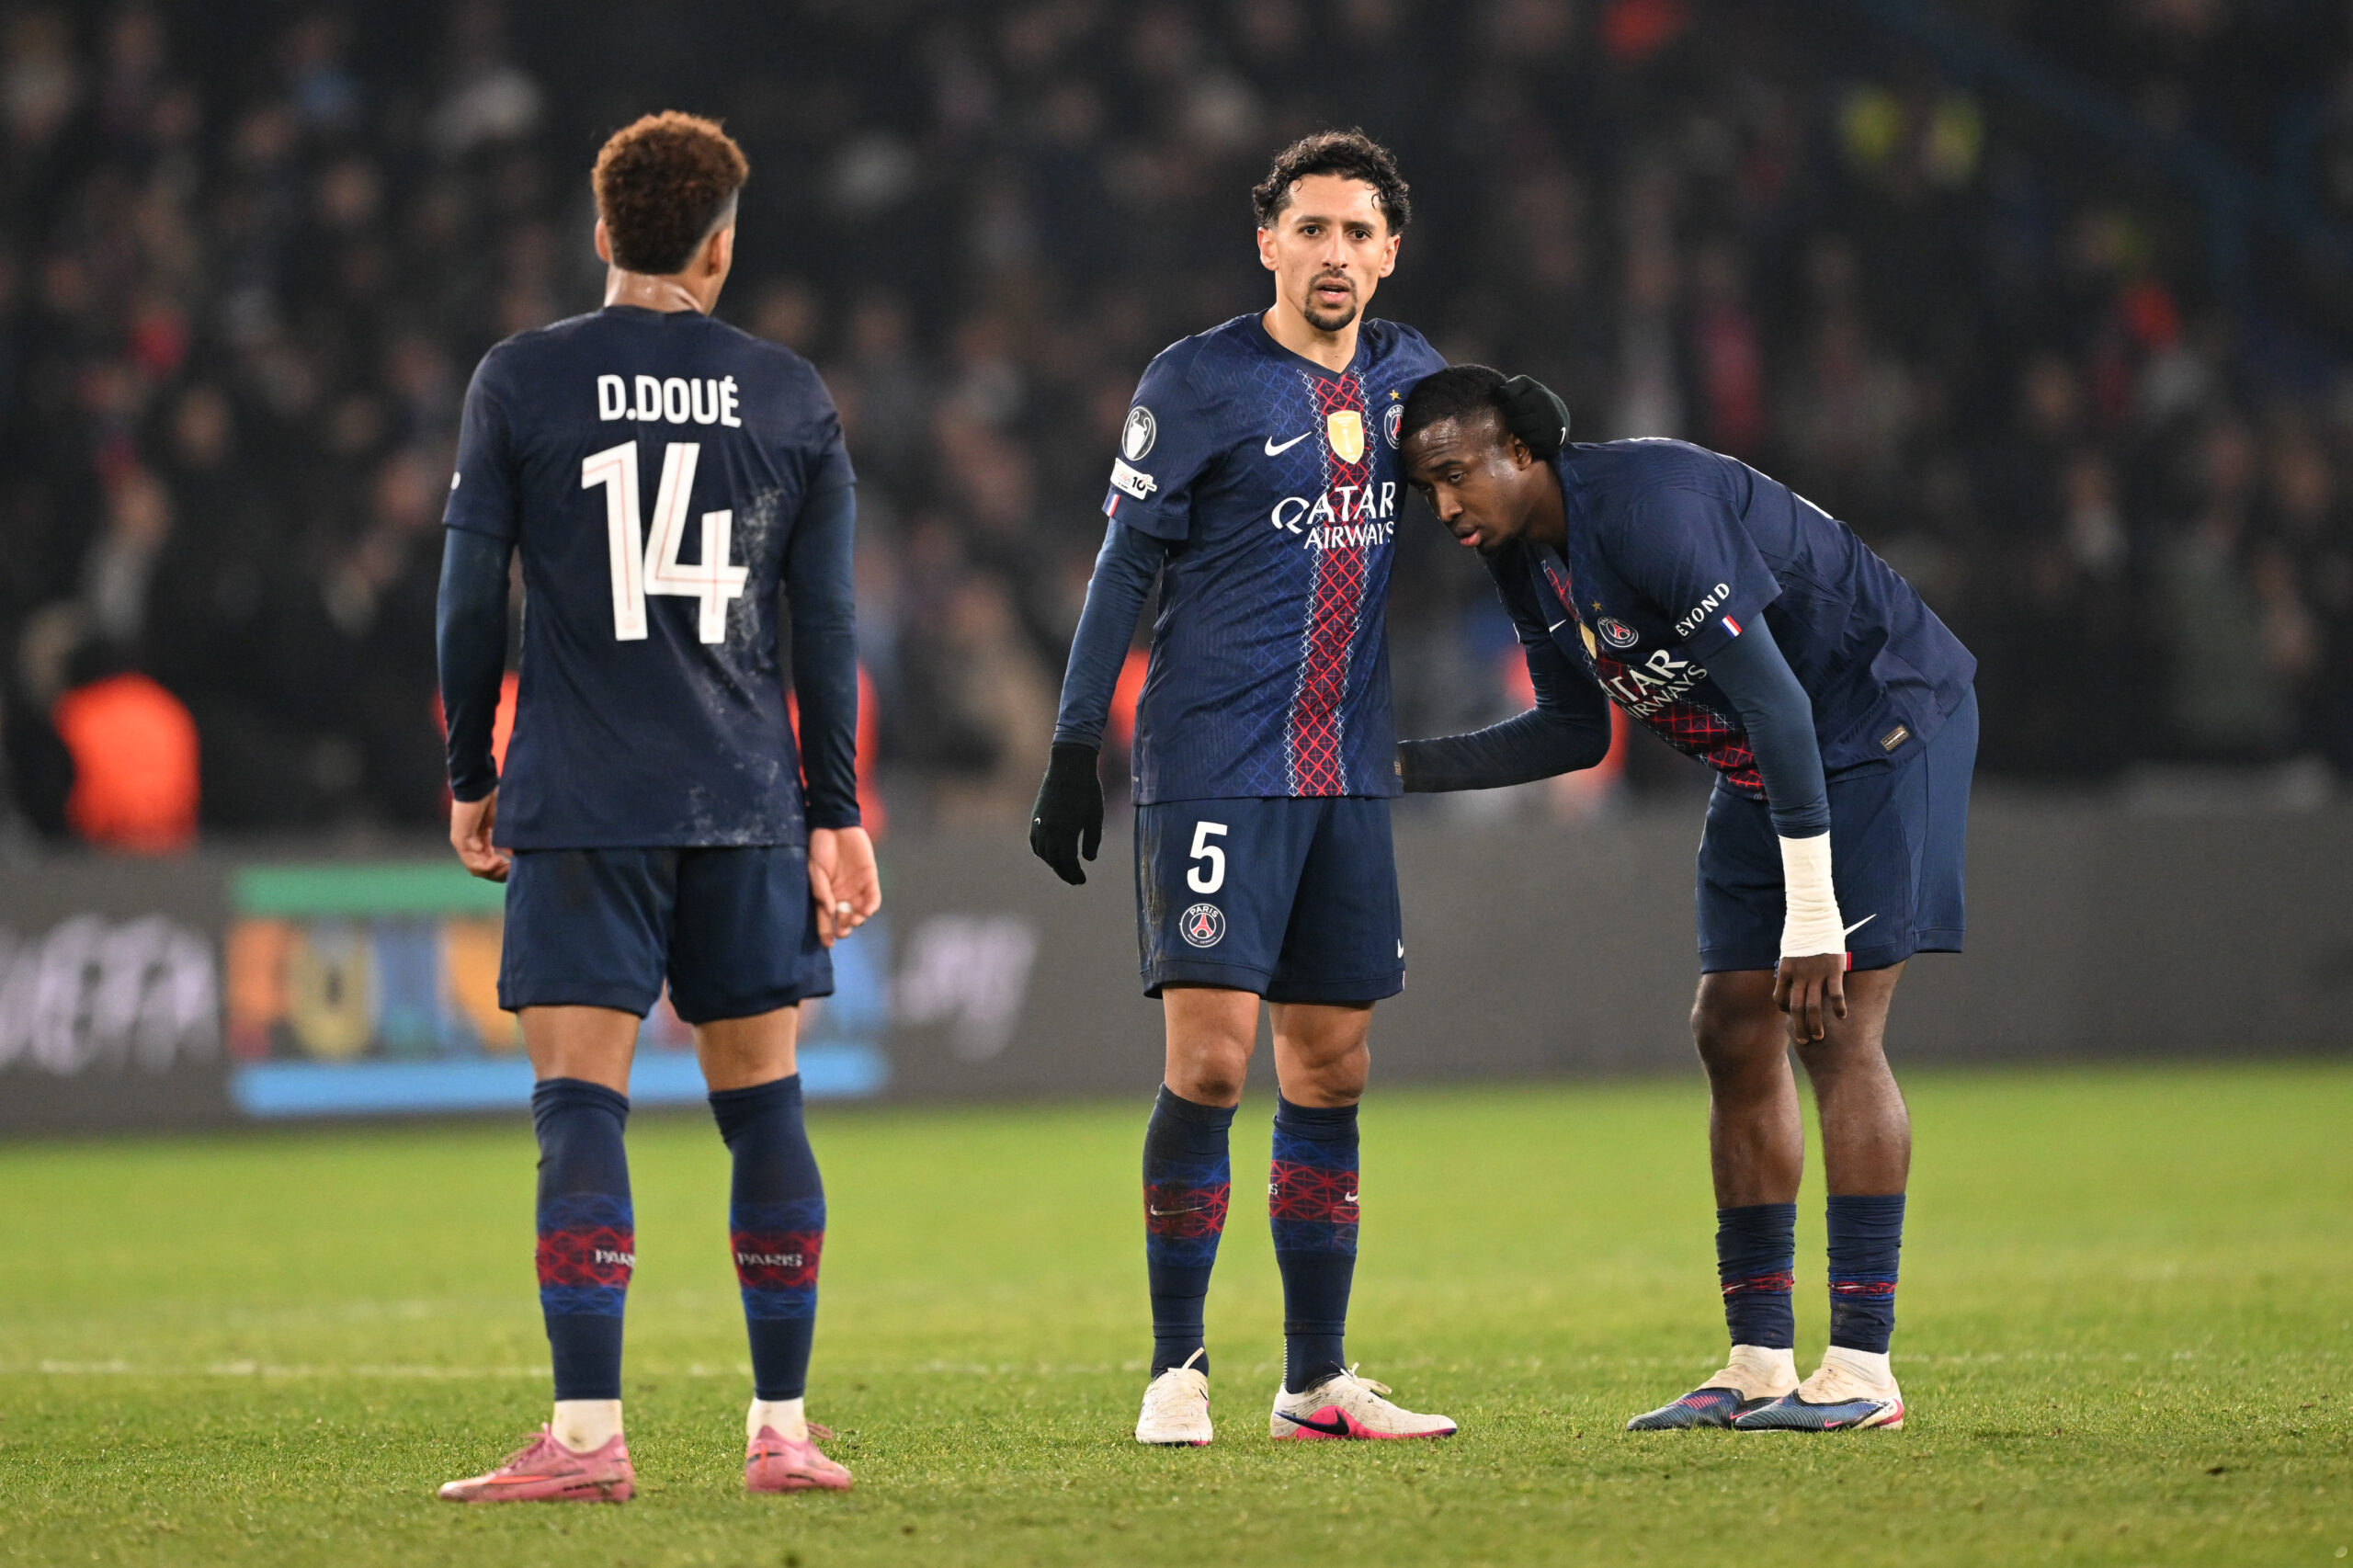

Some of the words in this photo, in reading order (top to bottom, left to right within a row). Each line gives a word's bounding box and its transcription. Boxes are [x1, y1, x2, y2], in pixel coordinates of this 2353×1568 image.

[597, 374, 742, 428] D.DOUÉ
[1388, 406, 1404, 418] PARI
[1271, 482, 1396, 534] QATAR
[1303, 520, 1394, 550] AIRWAYS
[581, 439, 750, 644] 14
[1675, 583, 1730, 637] EYOND
[1597, 649, 1689, 704] ATAR
[1625, 665, 1708, 719] IRWAYS
[1187, 821, 1228, 894] 5
[1189, 905, 1219, 918] PARIS
[737, 1252, 803, 1267] PARIS
